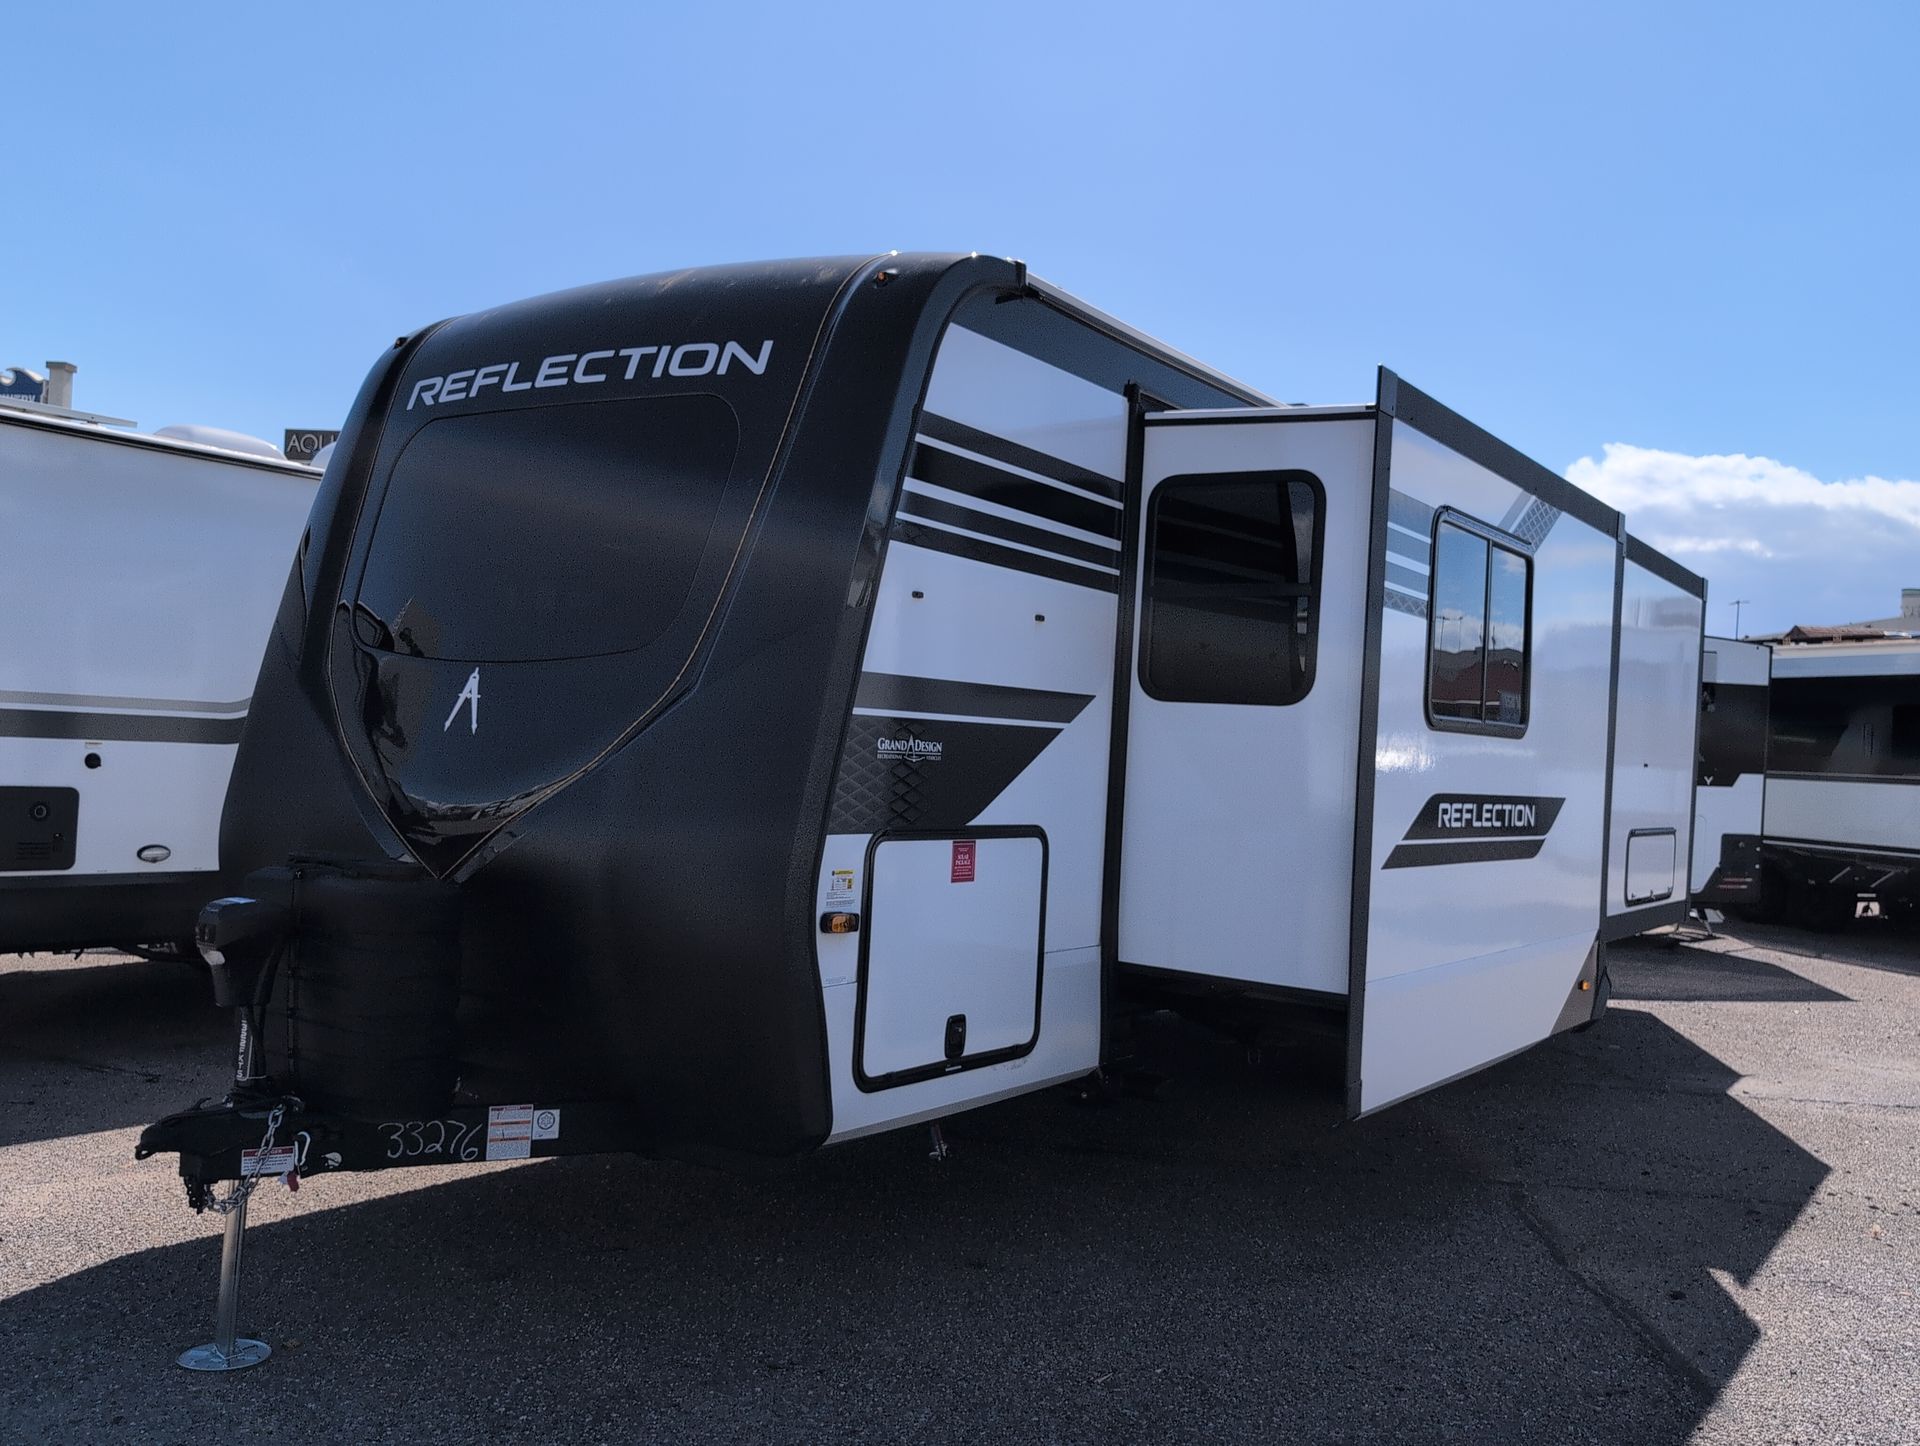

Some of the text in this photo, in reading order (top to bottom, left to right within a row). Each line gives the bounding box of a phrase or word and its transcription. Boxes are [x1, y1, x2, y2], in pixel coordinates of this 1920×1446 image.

[406, 339, 774, 411] REFLECTION
[877, 737, 943, 753] GRAND DESIGN
[1437, 803, 1536, 829] REFLECTION
[377, 1120, 483, 1162] 33276
